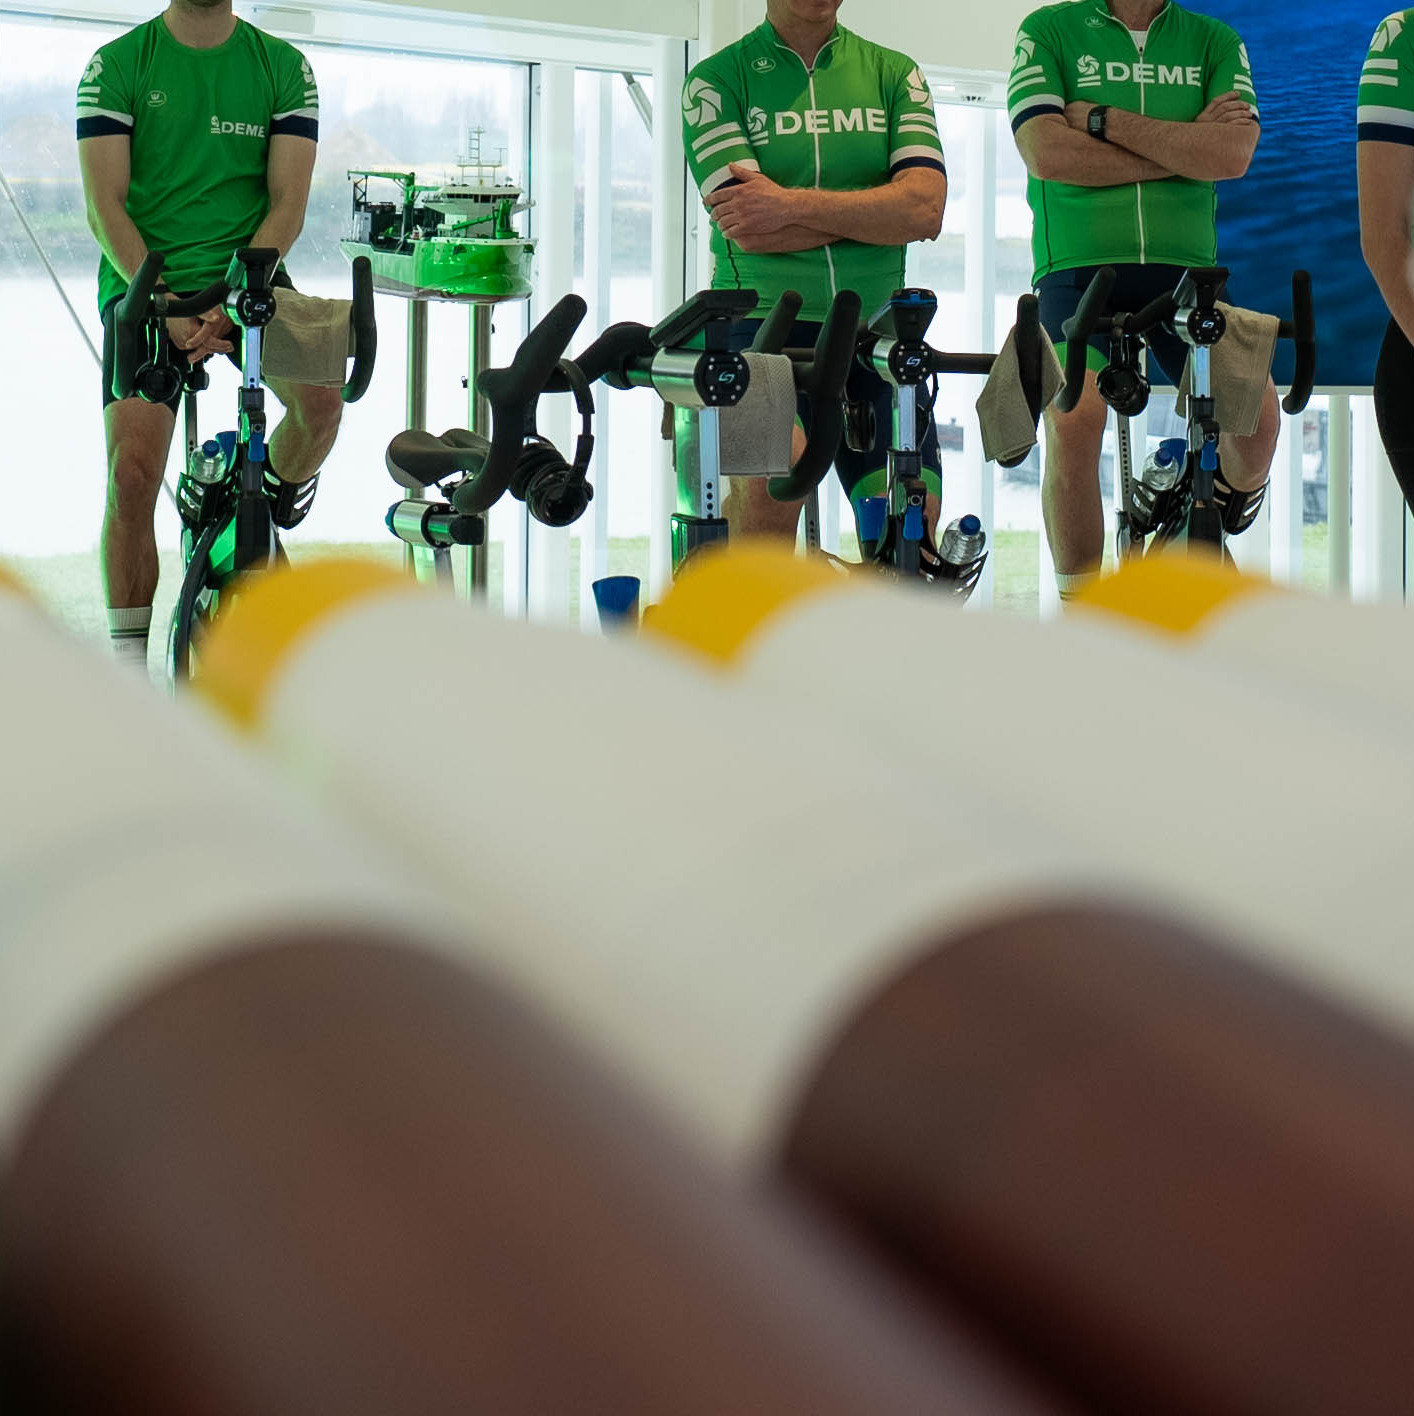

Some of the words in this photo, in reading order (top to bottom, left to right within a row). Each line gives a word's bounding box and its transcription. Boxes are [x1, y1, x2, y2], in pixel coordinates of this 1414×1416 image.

[1105, 61, 1202, 87] DEME
[221, 121, 266, 138] DEME
[774, 107, 888, 136] DEME
